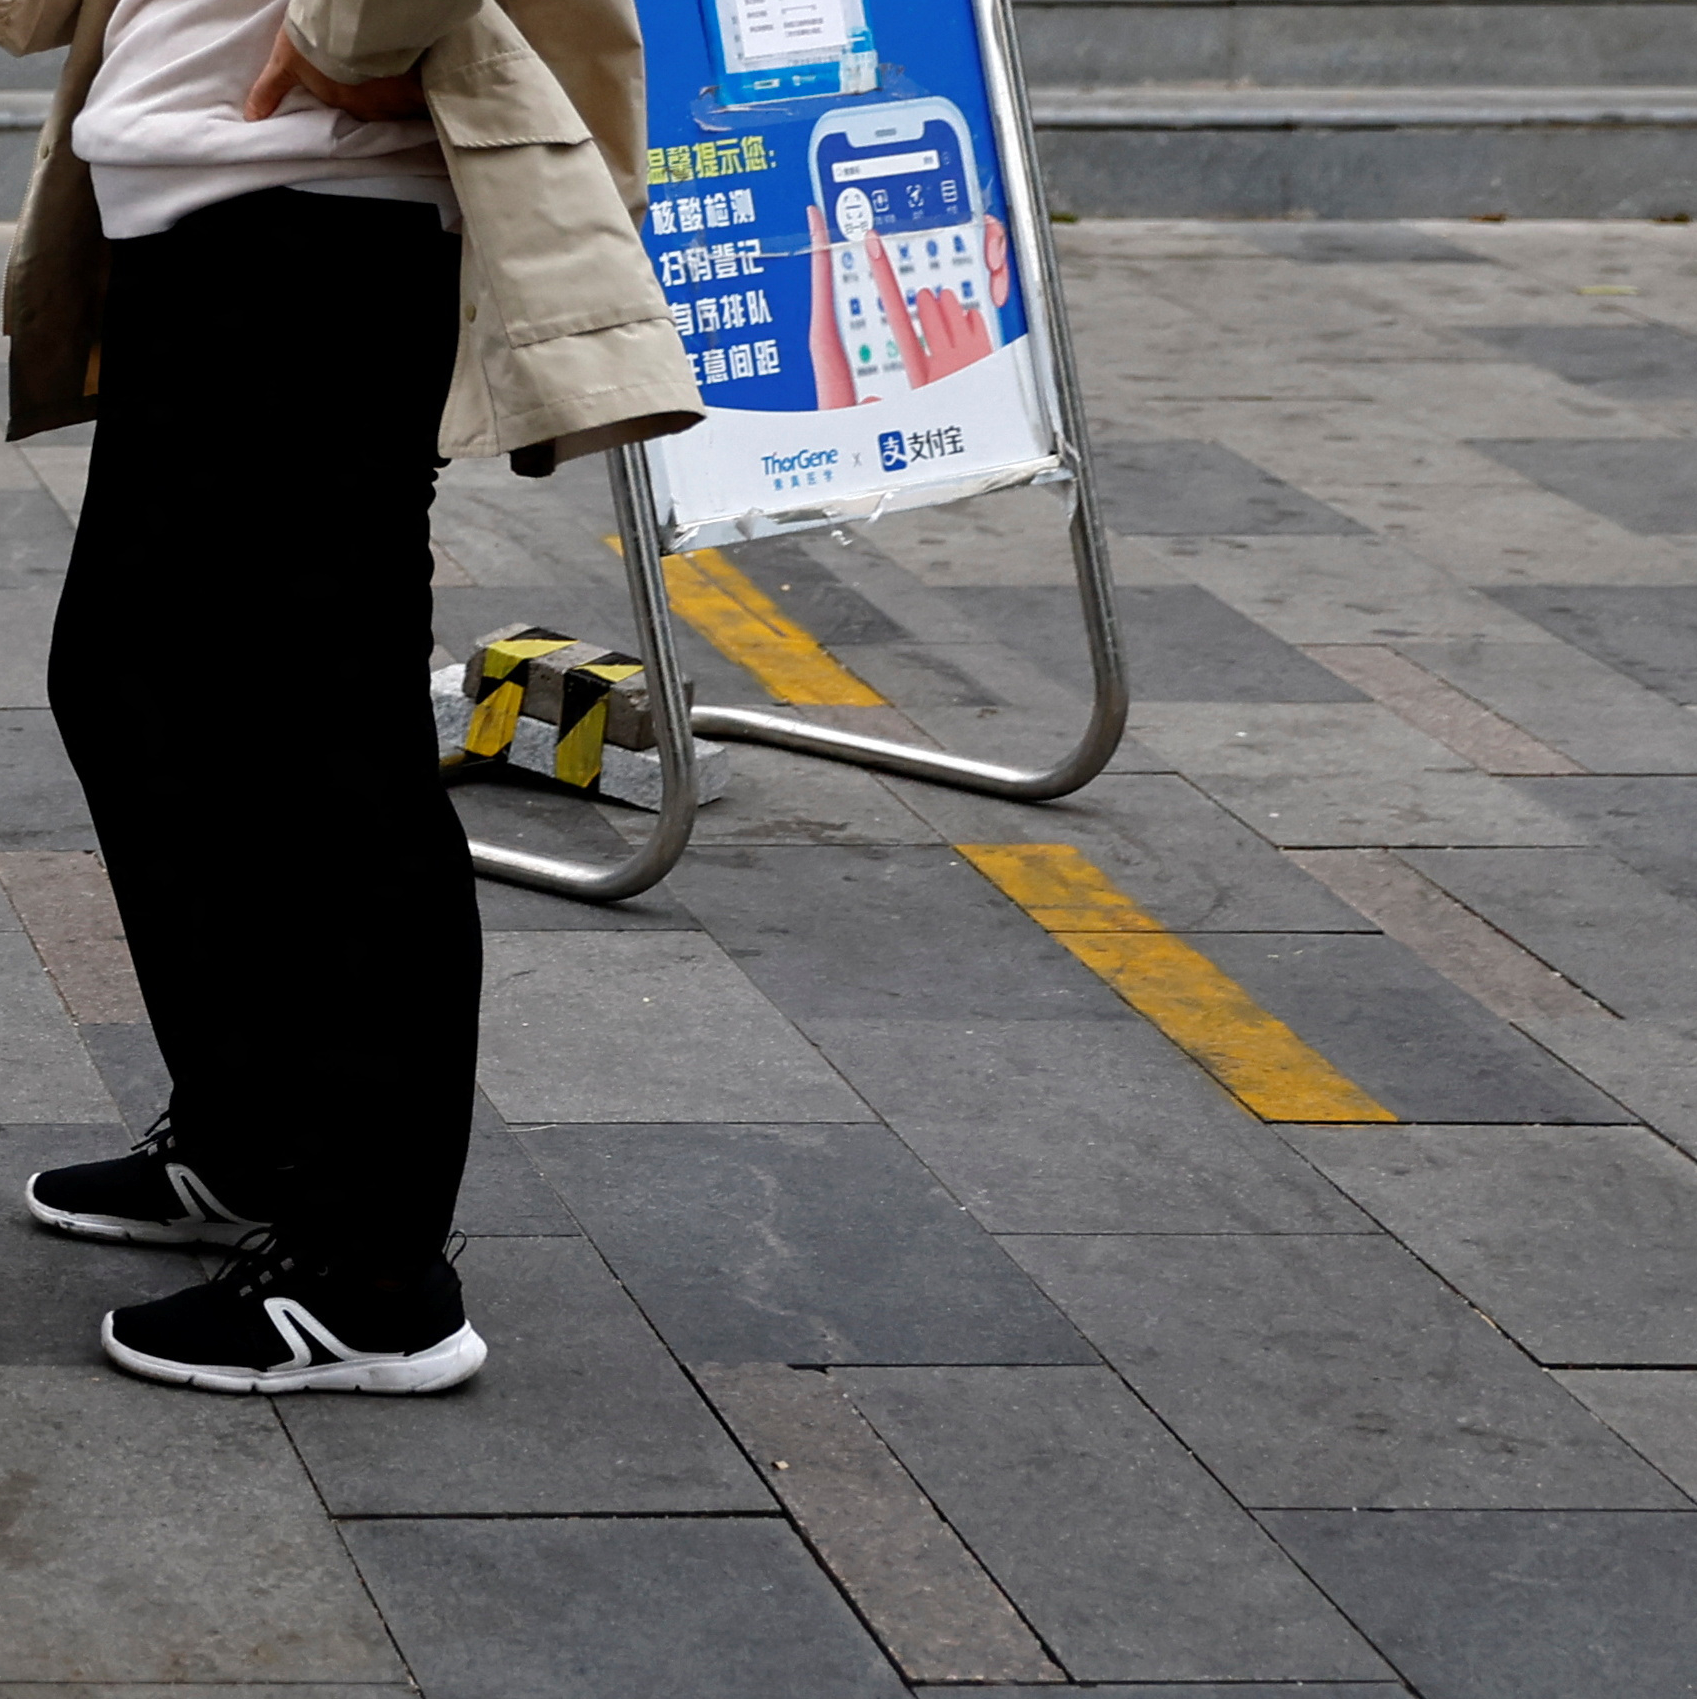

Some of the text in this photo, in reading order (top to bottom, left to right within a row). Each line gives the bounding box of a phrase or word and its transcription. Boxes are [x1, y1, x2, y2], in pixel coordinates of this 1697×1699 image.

[649, 188, 757, 236] 核酸检测
[658, 238, 765, 288] 扫码登记
[668, 289, 774, 337] 有序排队
[761, 447, 839, 476] ThorGene
[906, 424, 966, 463] 支付宝
